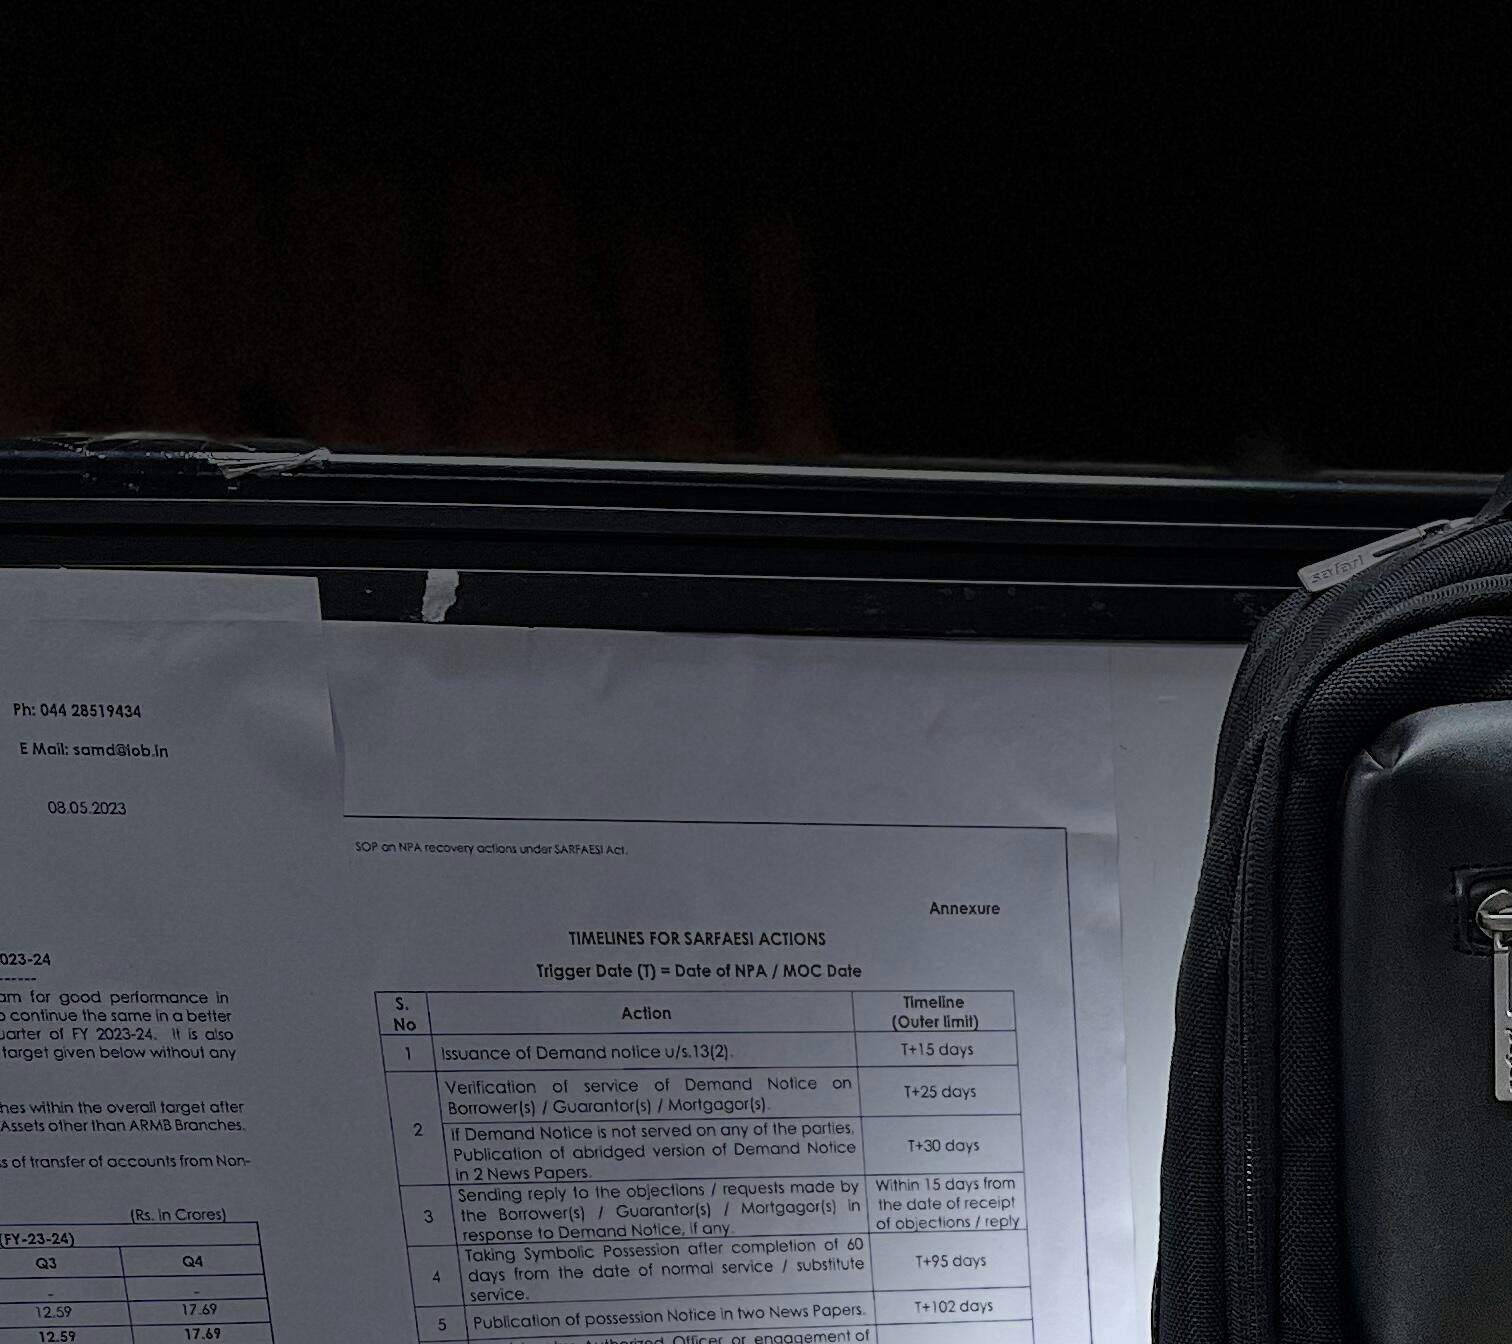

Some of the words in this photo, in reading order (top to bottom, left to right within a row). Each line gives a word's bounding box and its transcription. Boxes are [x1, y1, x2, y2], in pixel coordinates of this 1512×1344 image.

[13, 702, 36, 717] Ph:
[40, 703, 67, 717] 044
[71, 703, 142, 719] 28519434
[19, 742, 28, 755] E
[32, 741, 69, 757] Mail:
[72, 743, 169, 758] samd@iob.in
[47, 800, 127, 816] 08.05.2023
[355, 841, 378, 853] SOP
[398, 842, 422, 852] NPA
[424, 844, 474, 855] recovery
[476, 843, 517, 854] actions
[519, 844, 553, 855] under
[554, 844, 604, 855] SARFAESI
[929, 901, 1001, 915] Annexure
[568, 931, 645, 946] TIMELINES
[649, 931, 681, 946] FOR
[683, 931, 754, 946] SARFAESI
[758, 931, 826, 946] ACTIONS
[536, 963, 592, 981] Trigger
[595, 963, 633, 978] Date
[637, 963, 657, 981] (T)
[660, 967, 671, 975] =
[674, 963, 712, 978] Date
[715, 963, 731, 978] of
[734, 963, 768, 978] NPA
[771, 963, 779, 980] /
[783, 963, 822, 978] MOC
[827, 963, 863, 978] Date
[395, 996, 409, 1011] S.
[903, 995, 965, 1009] Timeline
[9, 1009, 78, 1022] continue
[82, 1008, 107, 1022] the
[110, 1011, 152, 1022] same
[155, 1011, 169, 1022] in
[172, 1012, 184, 1023] a
[186, 1009, 232, 1023] better
[621, 1006, 672, 1020] Action
[393, 1017, 417, 1032] No
[892, 1014, 939, 1032] (Outer
[943, 1014, 979, 1031] limit)
[49, 1027, 64, 1041] of
[72, 1027, 89, 1041] FY
[188, 1030, 198, 1041] is
[204, 1028, 234, 1041] also
[405, 1046, 411, 1061] 1
[441, 1047, 511, 1061] Issuance
[515, 1045, 531, 1060] of
[536, 1045, 607, 1060] Demand
[611, 1044, 661, 1059] notice
[901, 1042, 935, 1056] T+15
[938, 1043, 974, 1059] days
[904, 1085, 938, 1099] T+25
[941, 1085, 977, 1101] days
[0, 1119, 45, 1133] Assets
[47, 1119, 88, 1132] other
[91, 1119, 126, 1132] than
[129, 1118, 173, 1132] ARMB
[413, 1122, 423, 1137] 2
[908, 1139, 941, 1153] T+30
[945, 1139, 980, 1154] days
[174, 1208, 227, 1224] Crores)
[423, 1209, 434, 1224] 3
[35, 1257, 57, 1270] Q3
[182, 1255, 204, 1268] Q4
[915, 1254, 949, 1268] T+95
[952, 1255, 987, 1268] days
[432, 1270, 441, 1283] 4
[35, 1305, 73, 1319] 12.59
[182, 1302, 218, 1316] 17.69
[915, 1300, 956, 1313] T+102
[959, 1300, 993, 1314] days
[438, 1317, 447, 1332] 5
[38, 1330, 76, 1343] 12.59
[184, 1327, 221, 1341] 17.69
